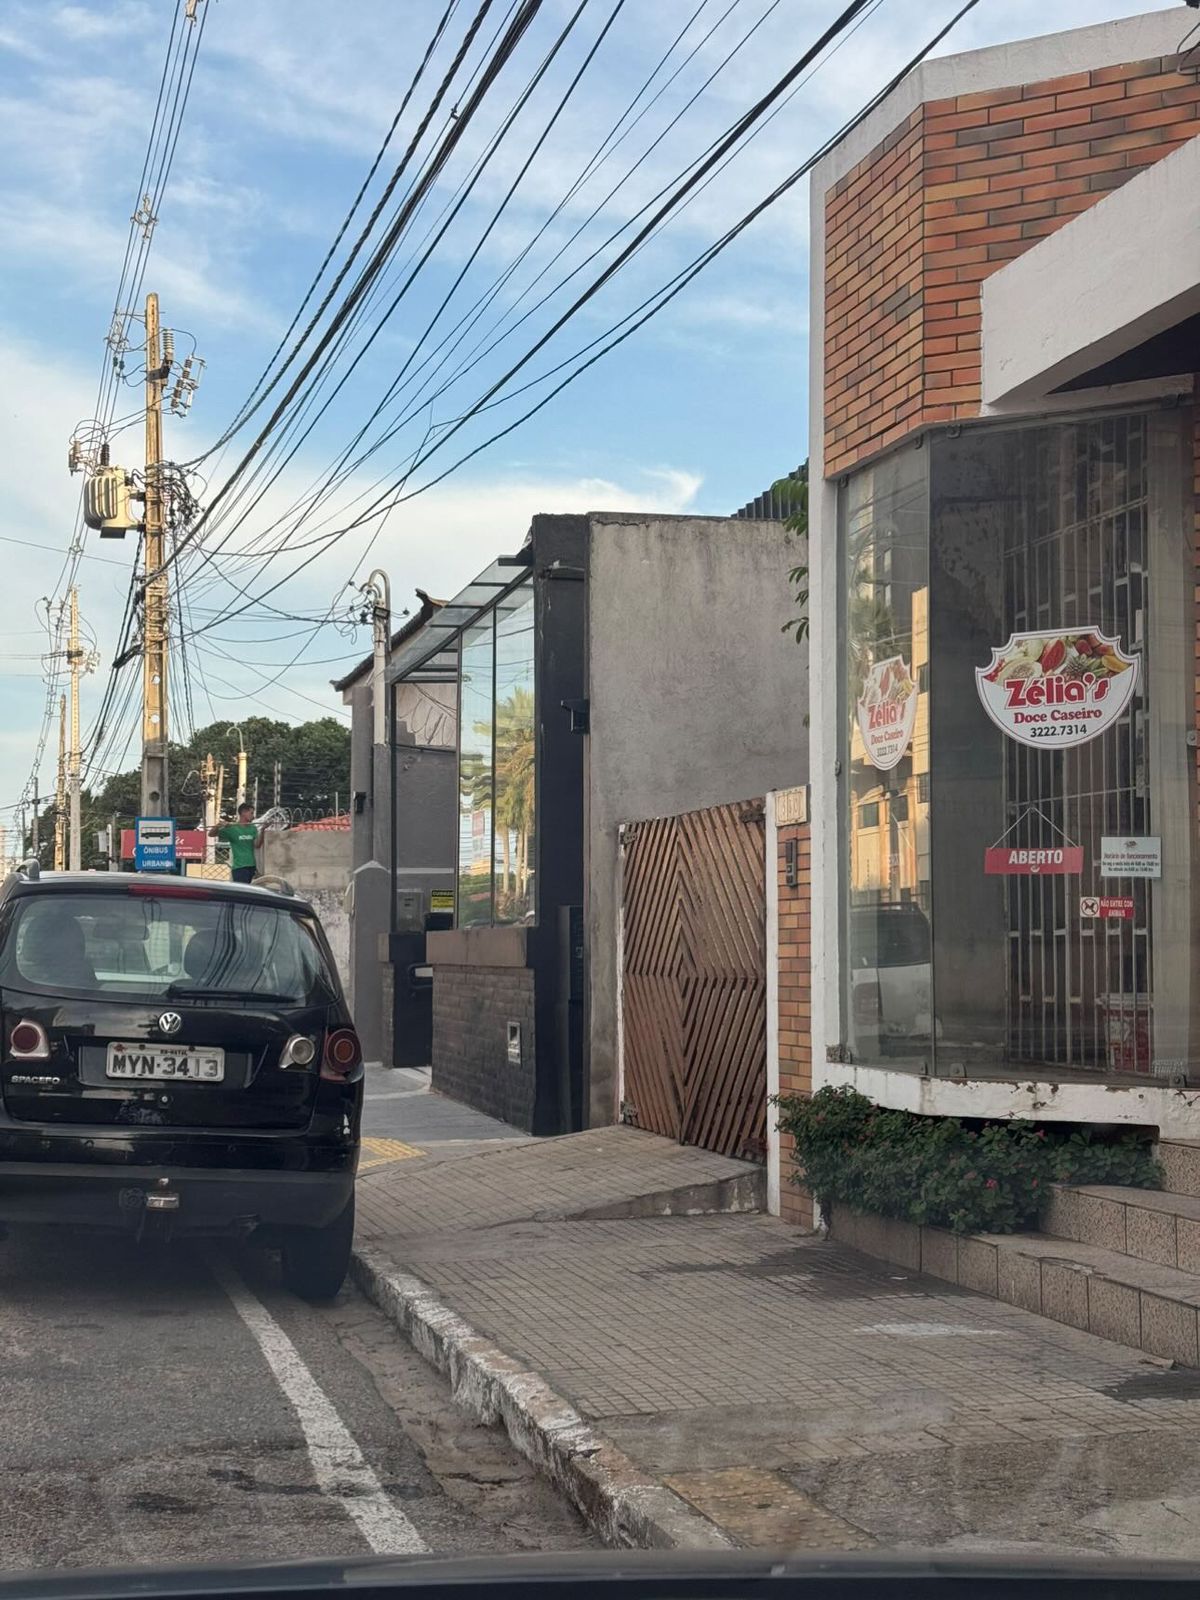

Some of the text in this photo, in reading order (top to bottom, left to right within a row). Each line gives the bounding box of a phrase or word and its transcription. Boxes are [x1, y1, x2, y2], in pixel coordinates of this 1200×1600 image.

[1005, 673, 1110, 708] Zélia's
[1014, 707, 1103, 724] Doce Caseiro
[1030, 724, 1087, 738] 3222.7314
[144, 846, 168, 854] ÔNIBUS
[1008, 850, 1063, 864] ABERTO
